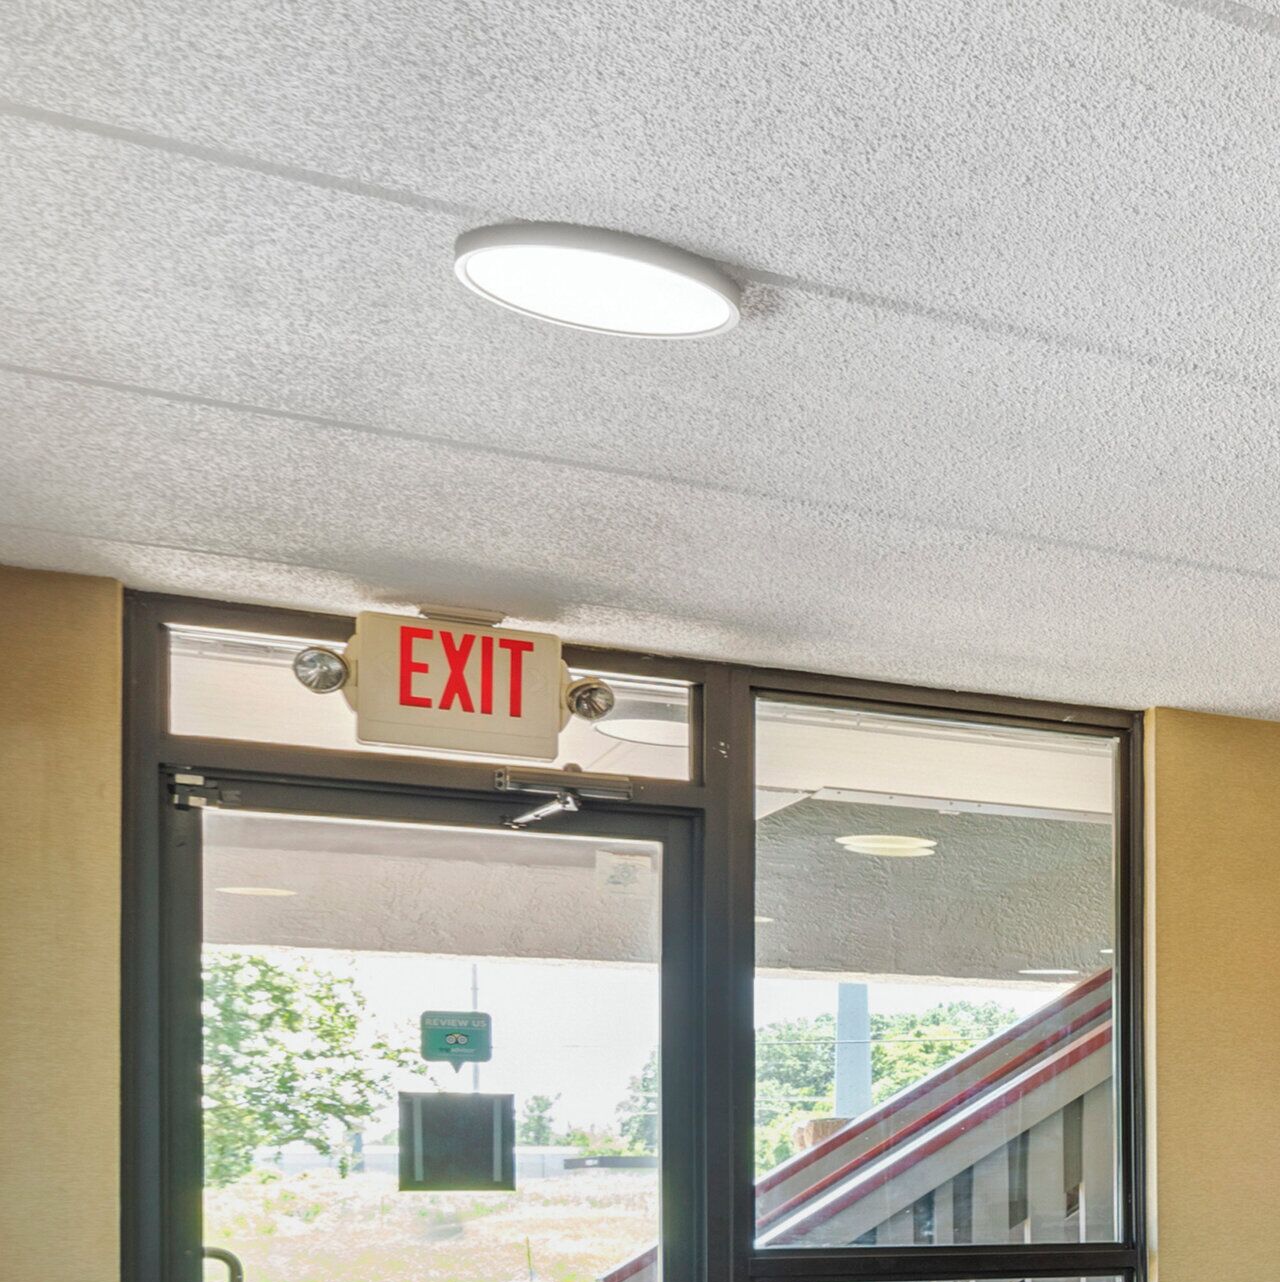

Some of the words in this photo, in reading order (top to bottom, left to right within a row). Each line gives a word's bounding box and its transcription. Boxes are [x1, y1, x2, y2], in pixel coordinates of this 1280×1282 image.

[399, 626, 534, 718] EXIT
[425, 1018, 468, 1027] REVIEW
[472, 1019, 487, 1028] US
